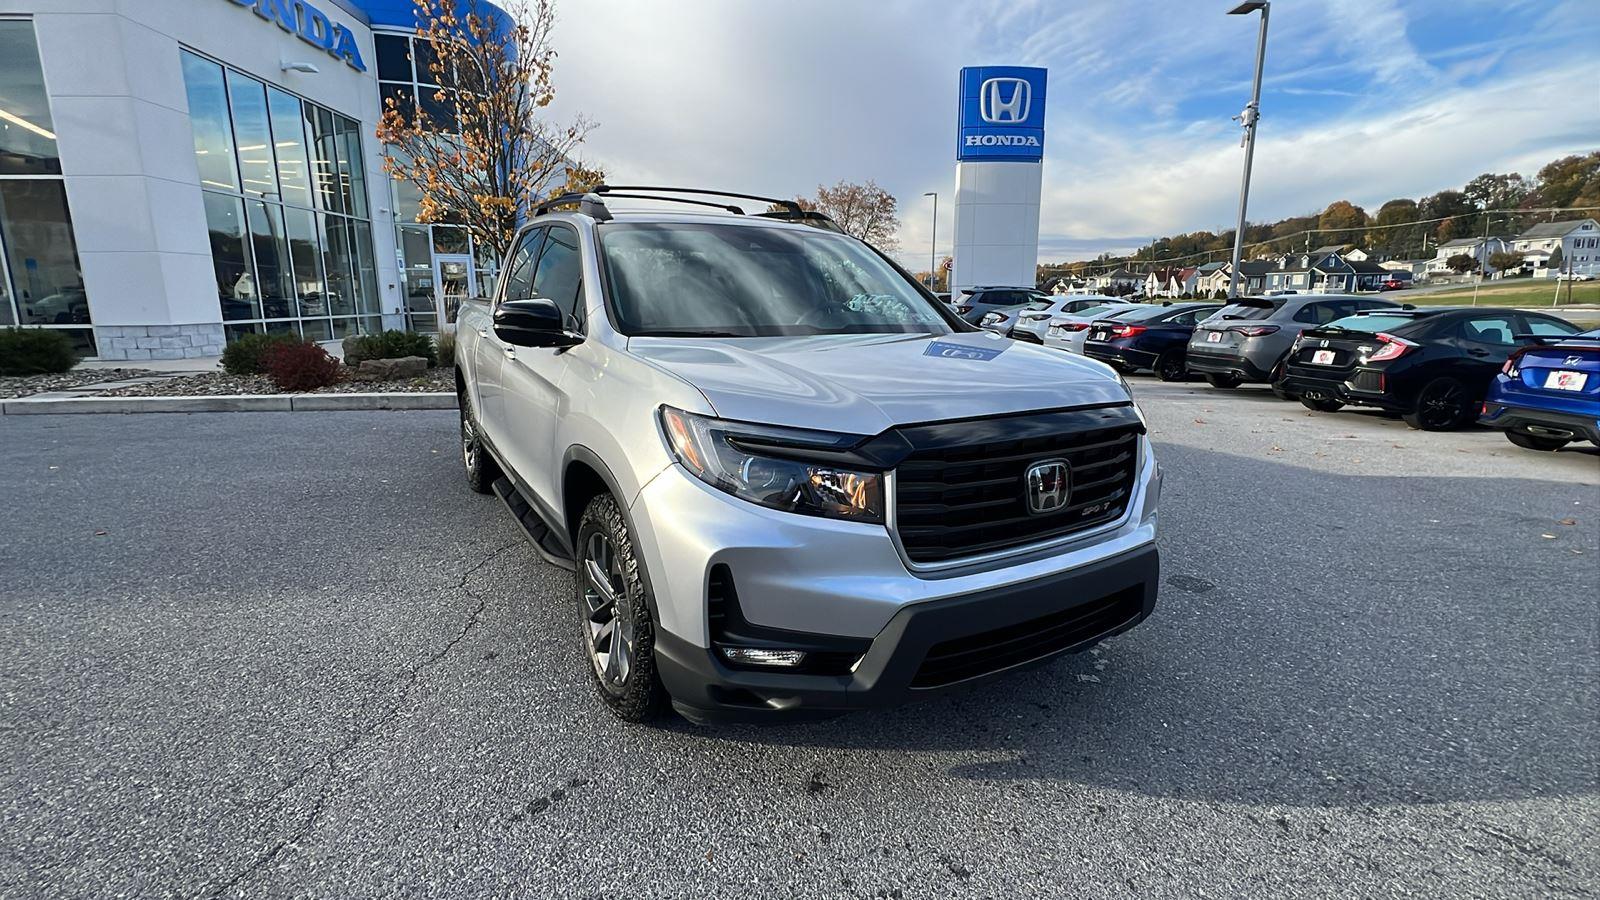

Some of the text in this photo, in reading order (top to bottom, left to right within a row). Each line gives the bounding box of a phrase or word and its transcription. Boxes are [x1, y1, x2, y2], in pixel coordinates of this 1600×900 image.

[222, 0, 368, 73] NDA
[965, 135, 1041, 147] HONDA
[1081, 501, 1110, 516] SPOT
